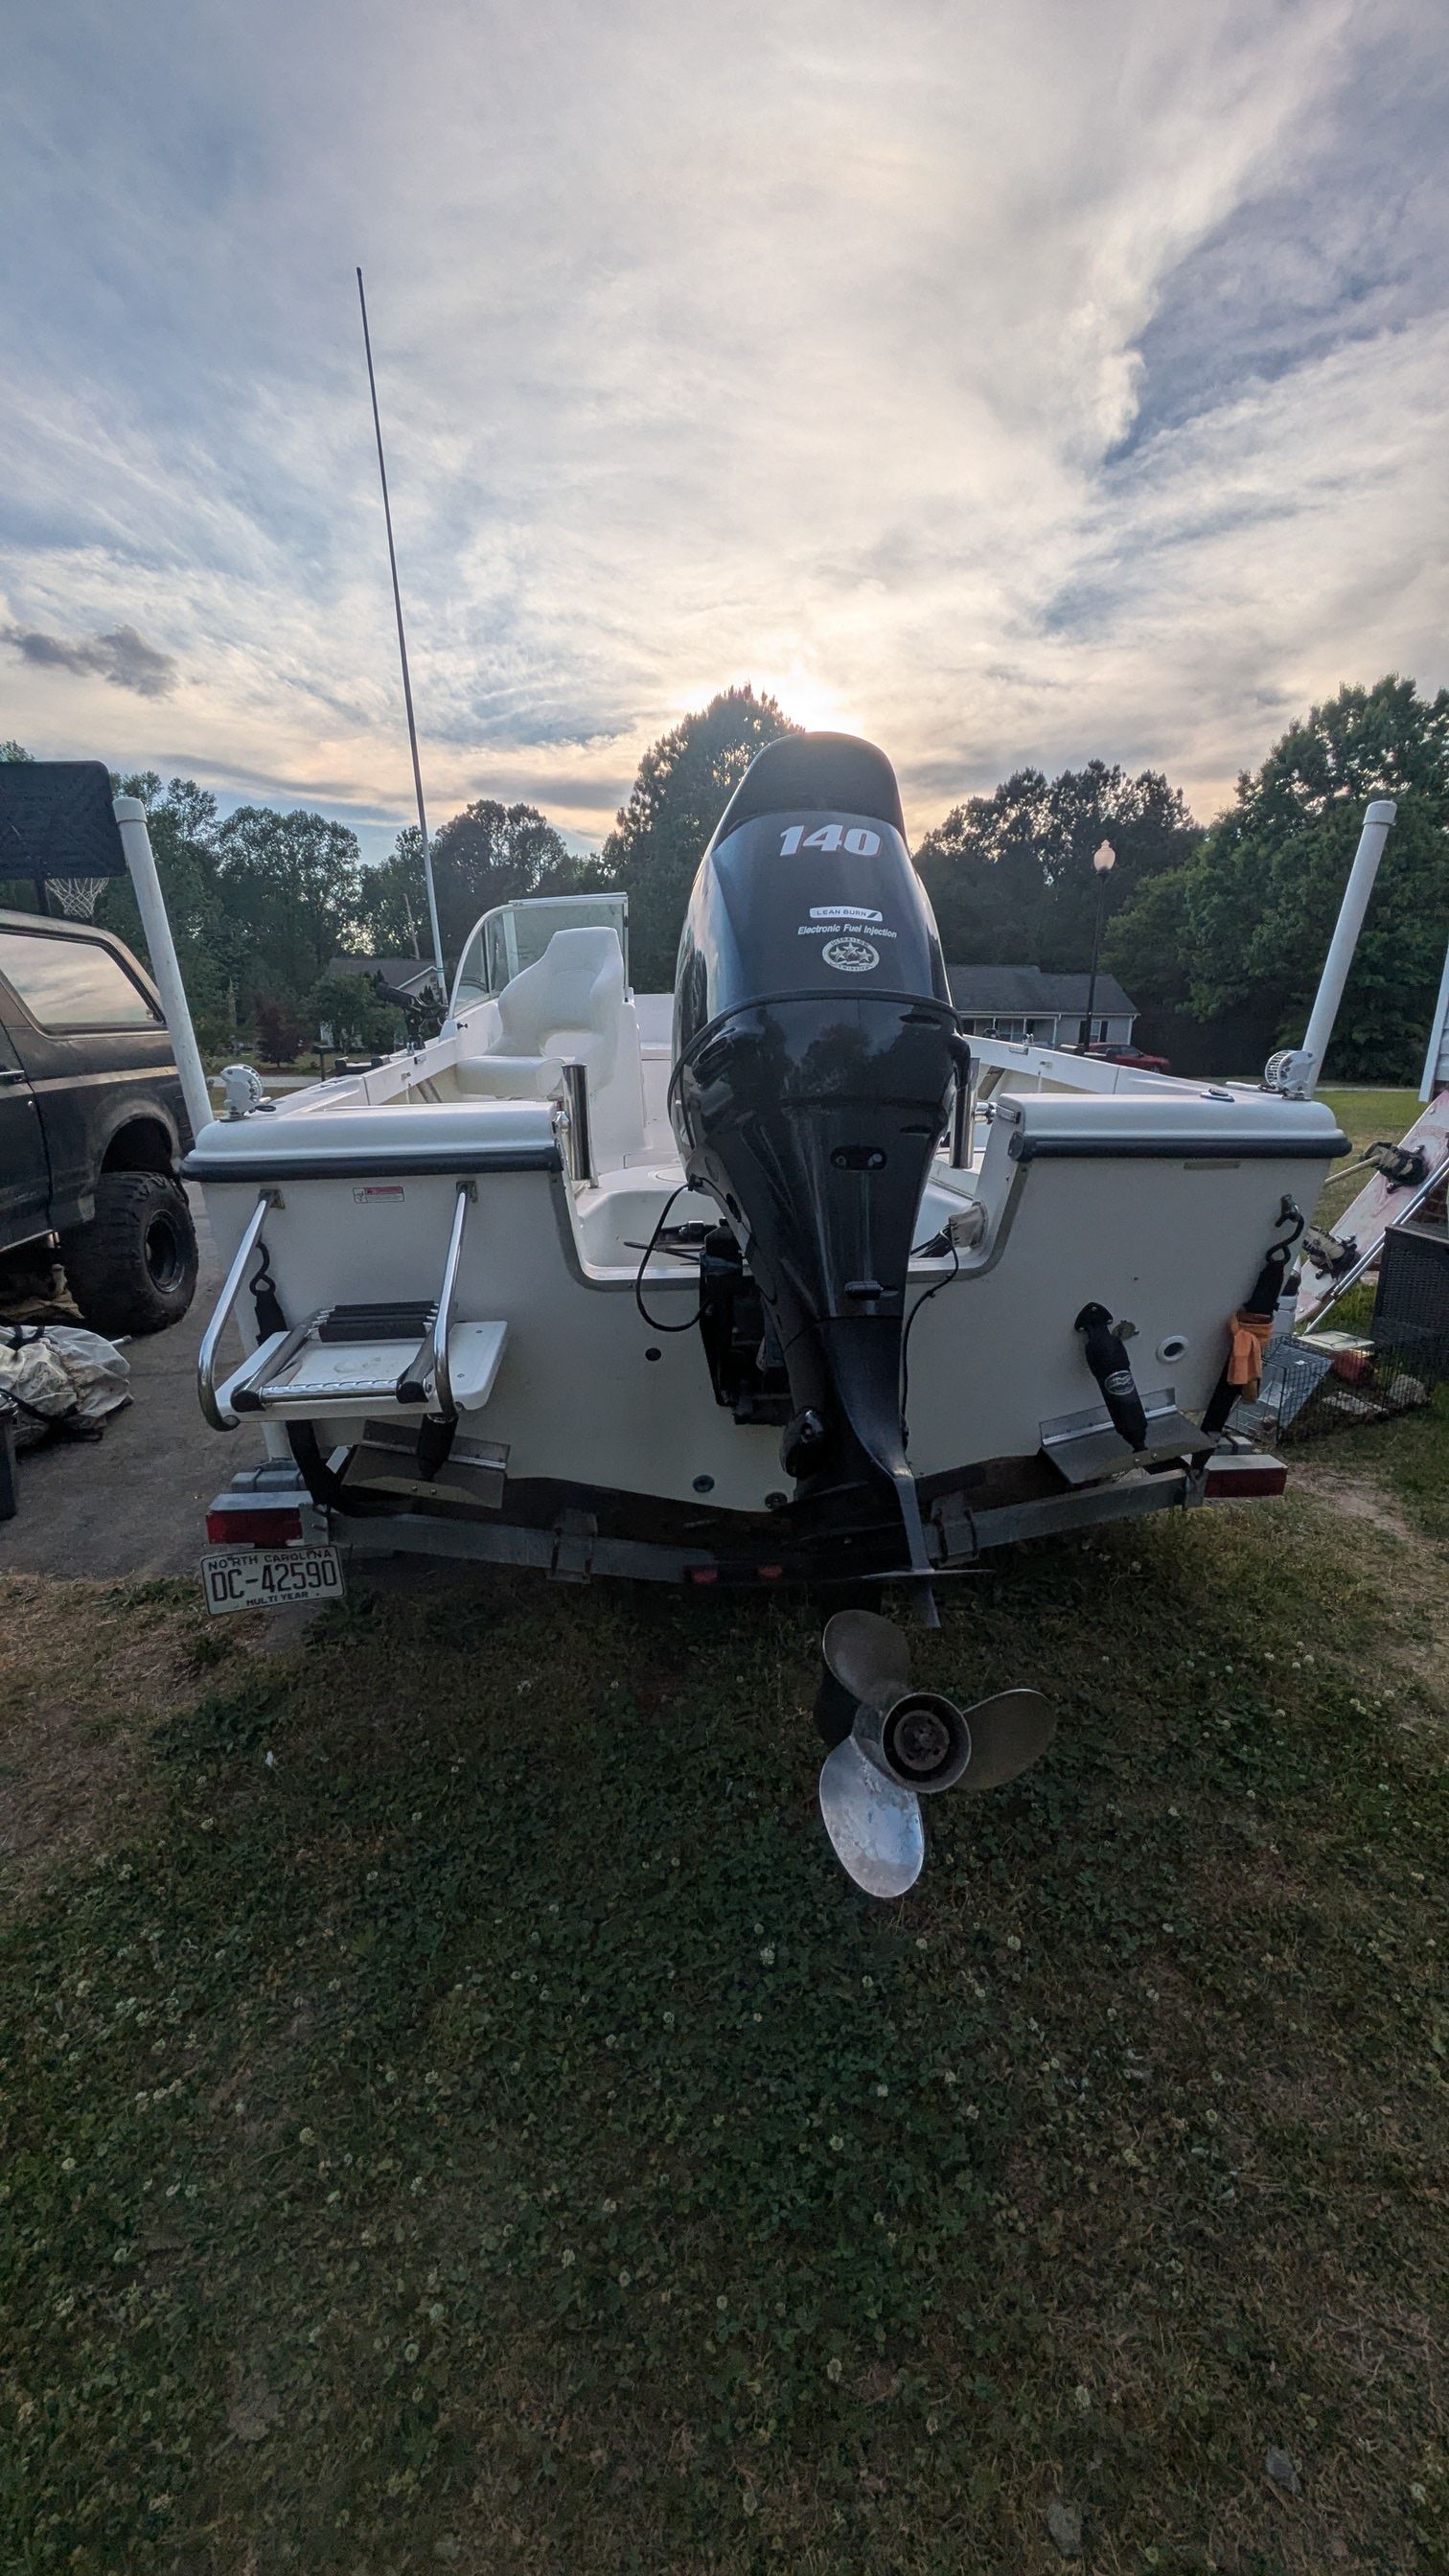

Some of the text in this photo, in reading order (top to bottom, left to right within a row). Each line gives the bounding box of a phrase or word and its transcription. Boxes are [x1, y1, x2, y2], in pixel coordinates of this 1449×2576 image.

[780, 824, 882, 857] 140
[797, 923, 898, 938] Electronic Fuel Injection
[208, 1549, 333, 1572] NORTH CAROLINA
[211, 1560, 337, 1602] DC-42590
[246, 1591, 309, 1606] MULTI YEAR
